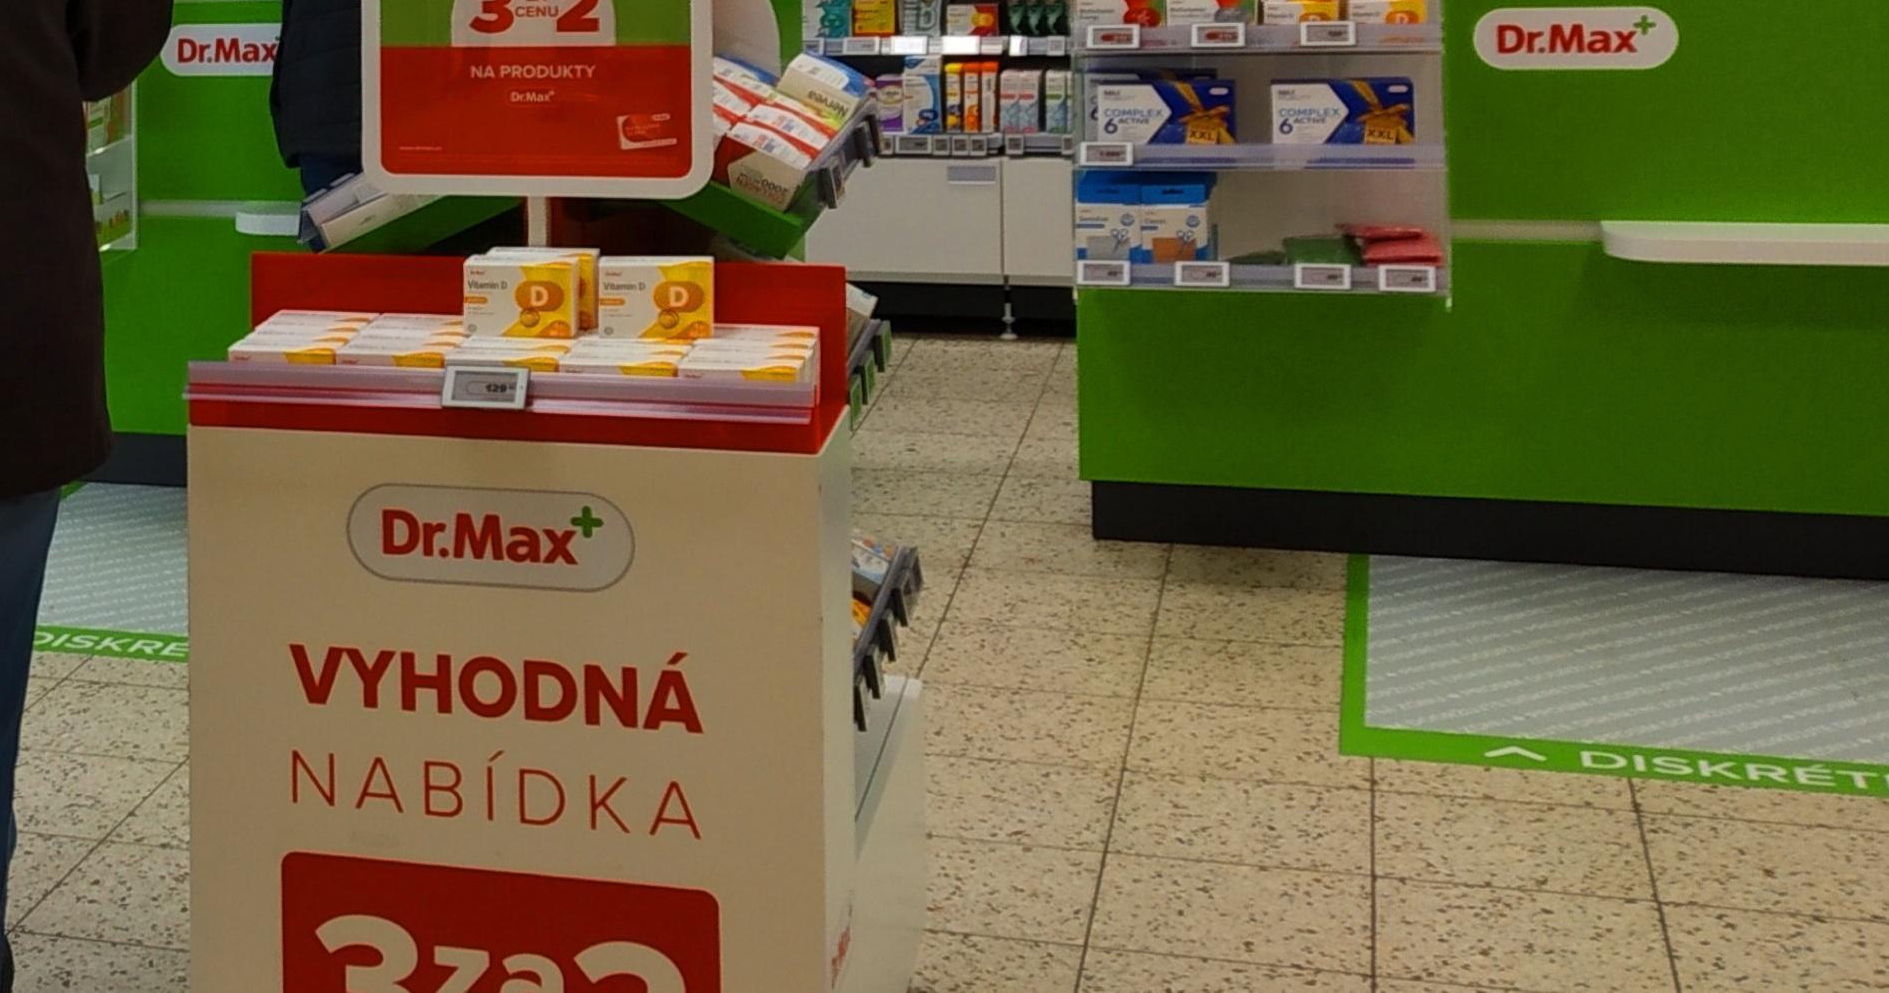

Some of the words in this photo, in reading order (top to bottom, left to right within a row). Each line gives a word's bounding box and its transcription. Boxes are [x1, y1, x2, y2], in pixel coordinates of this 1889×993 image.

[515, 6, 559, 18] CENU
[1496, 23, 1638, 54] Dr.Max
[177, 37, 278, 64] Dr.Max
[470, 65, 496, 79] NA
[499, 64, 597, 80] PRODUKTY
[510, 91, 551, 102] Dr.Max
[1104, 108, 1163, 118] COMPLEX
[1279, 107, 1342, 117] COMPLEX
[1104, 117, 1118, 134] 6
[1279, 117, 1293, 134] 6
[1189, 128, 1217, 142] XXL
[1367, 128, 1395, 142] XXL
[467, 280, 498, 290] Vitamin
[501, 280, 508, 290] D
[603, 281, 637, 291] Vitamin
[639, 281, 646, 290] D
[530, 285, 549, 307] D
[669, 285, 689, 307] D
[380, 508, 580, 566] Dr.Max
[288, 643, 704, 735] VYHODNÁ
[291, 750, 702, 840] NABÍDKA
